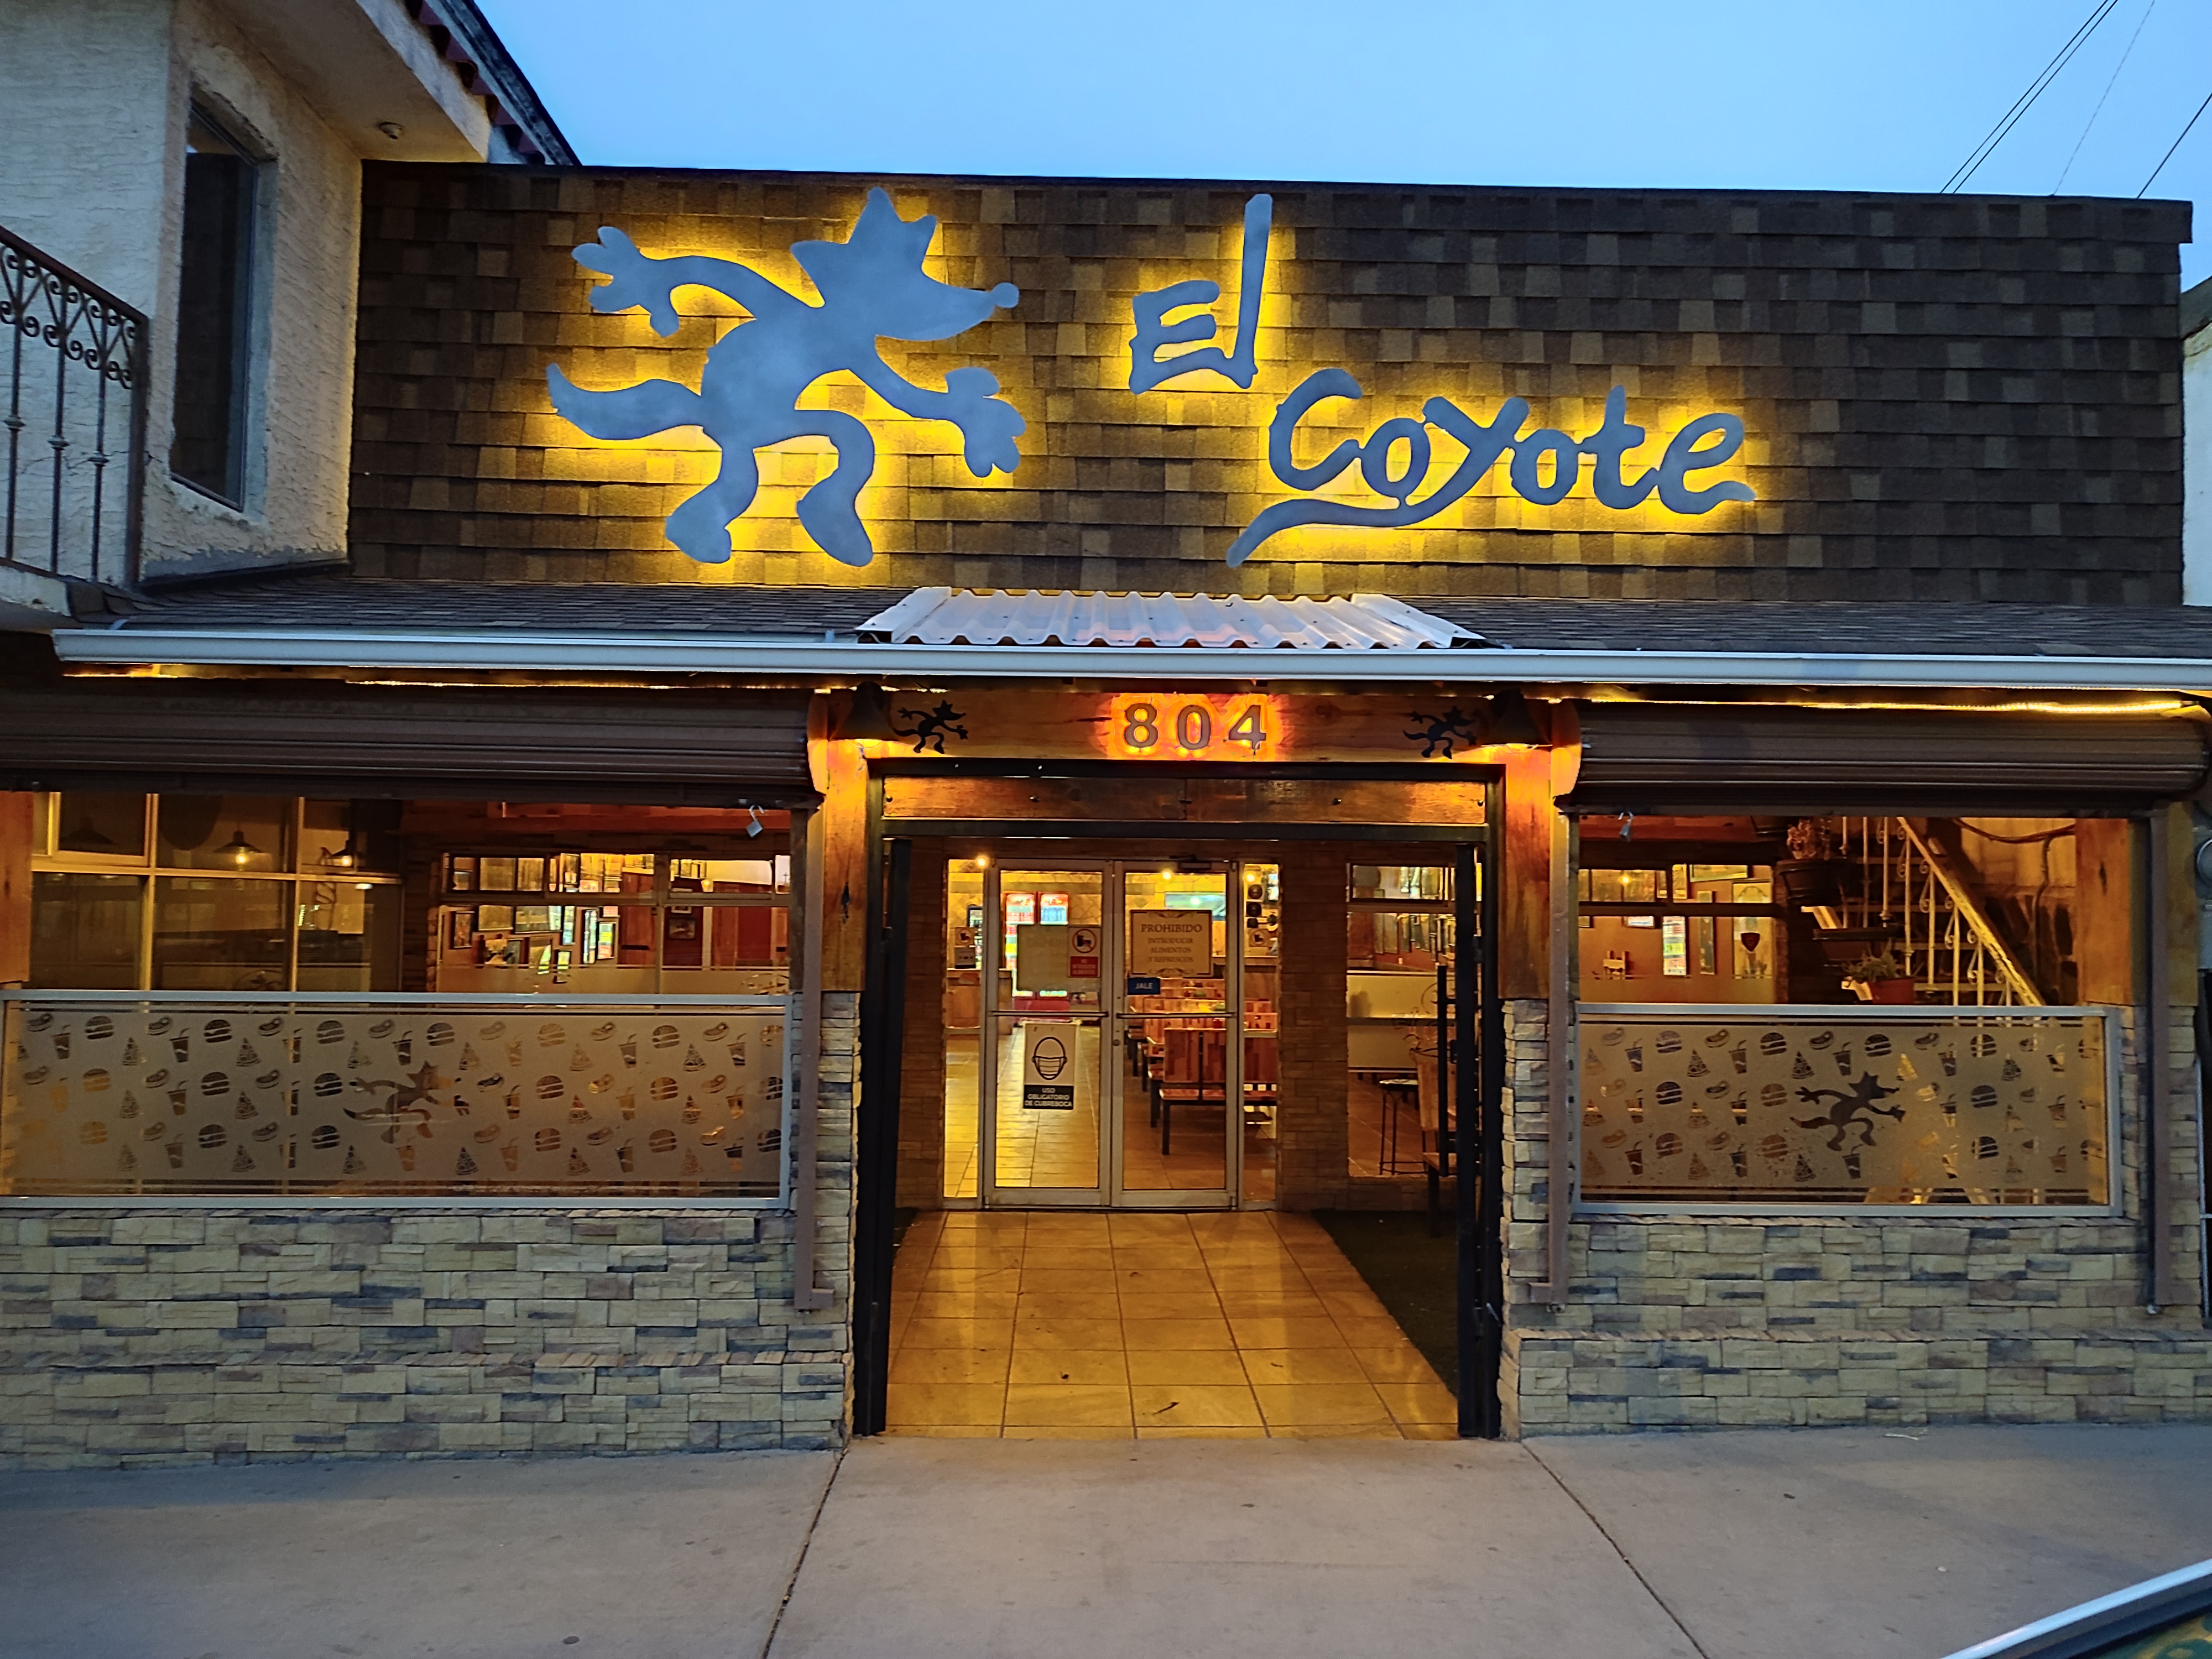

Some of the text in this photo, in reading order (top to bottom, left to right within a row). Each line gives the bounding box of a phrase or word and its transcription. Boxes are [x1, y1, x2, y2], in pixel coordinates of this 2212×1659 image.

[1129, 193, 1273, 394] El
[1226, 368, 1756, 568] Coyote
[1124, 703, 1266, 750] 804
[1141, 924, 1202, 932] PROHIBIDO
